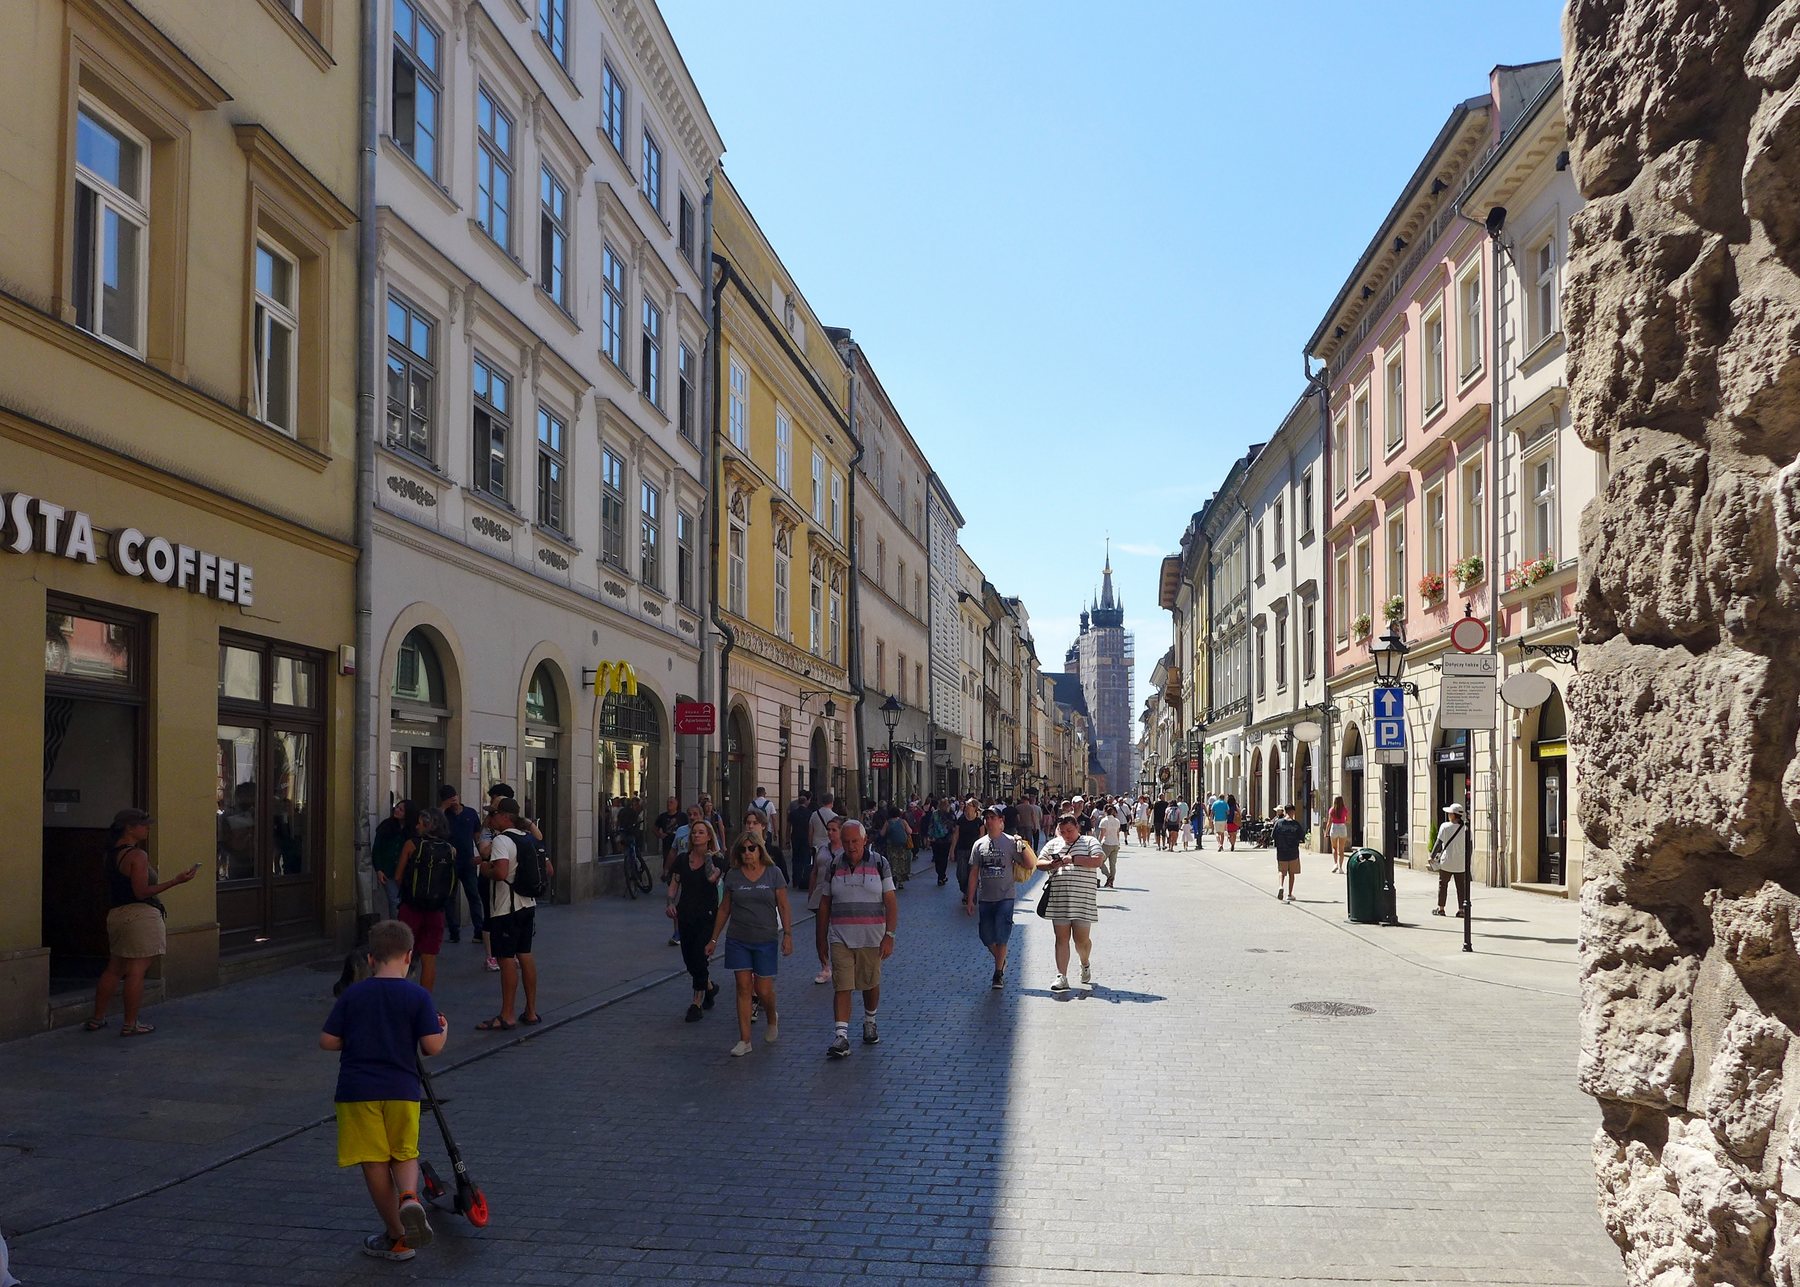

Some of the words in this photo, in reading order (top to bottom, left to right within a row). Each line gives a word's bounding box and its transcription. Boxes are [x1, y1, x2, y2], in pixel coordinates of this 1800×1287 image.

[0, 491, 98, 566] STA
[116, 527, 254, 607] COFFEE
[1381, 722, 1398, 745] P
